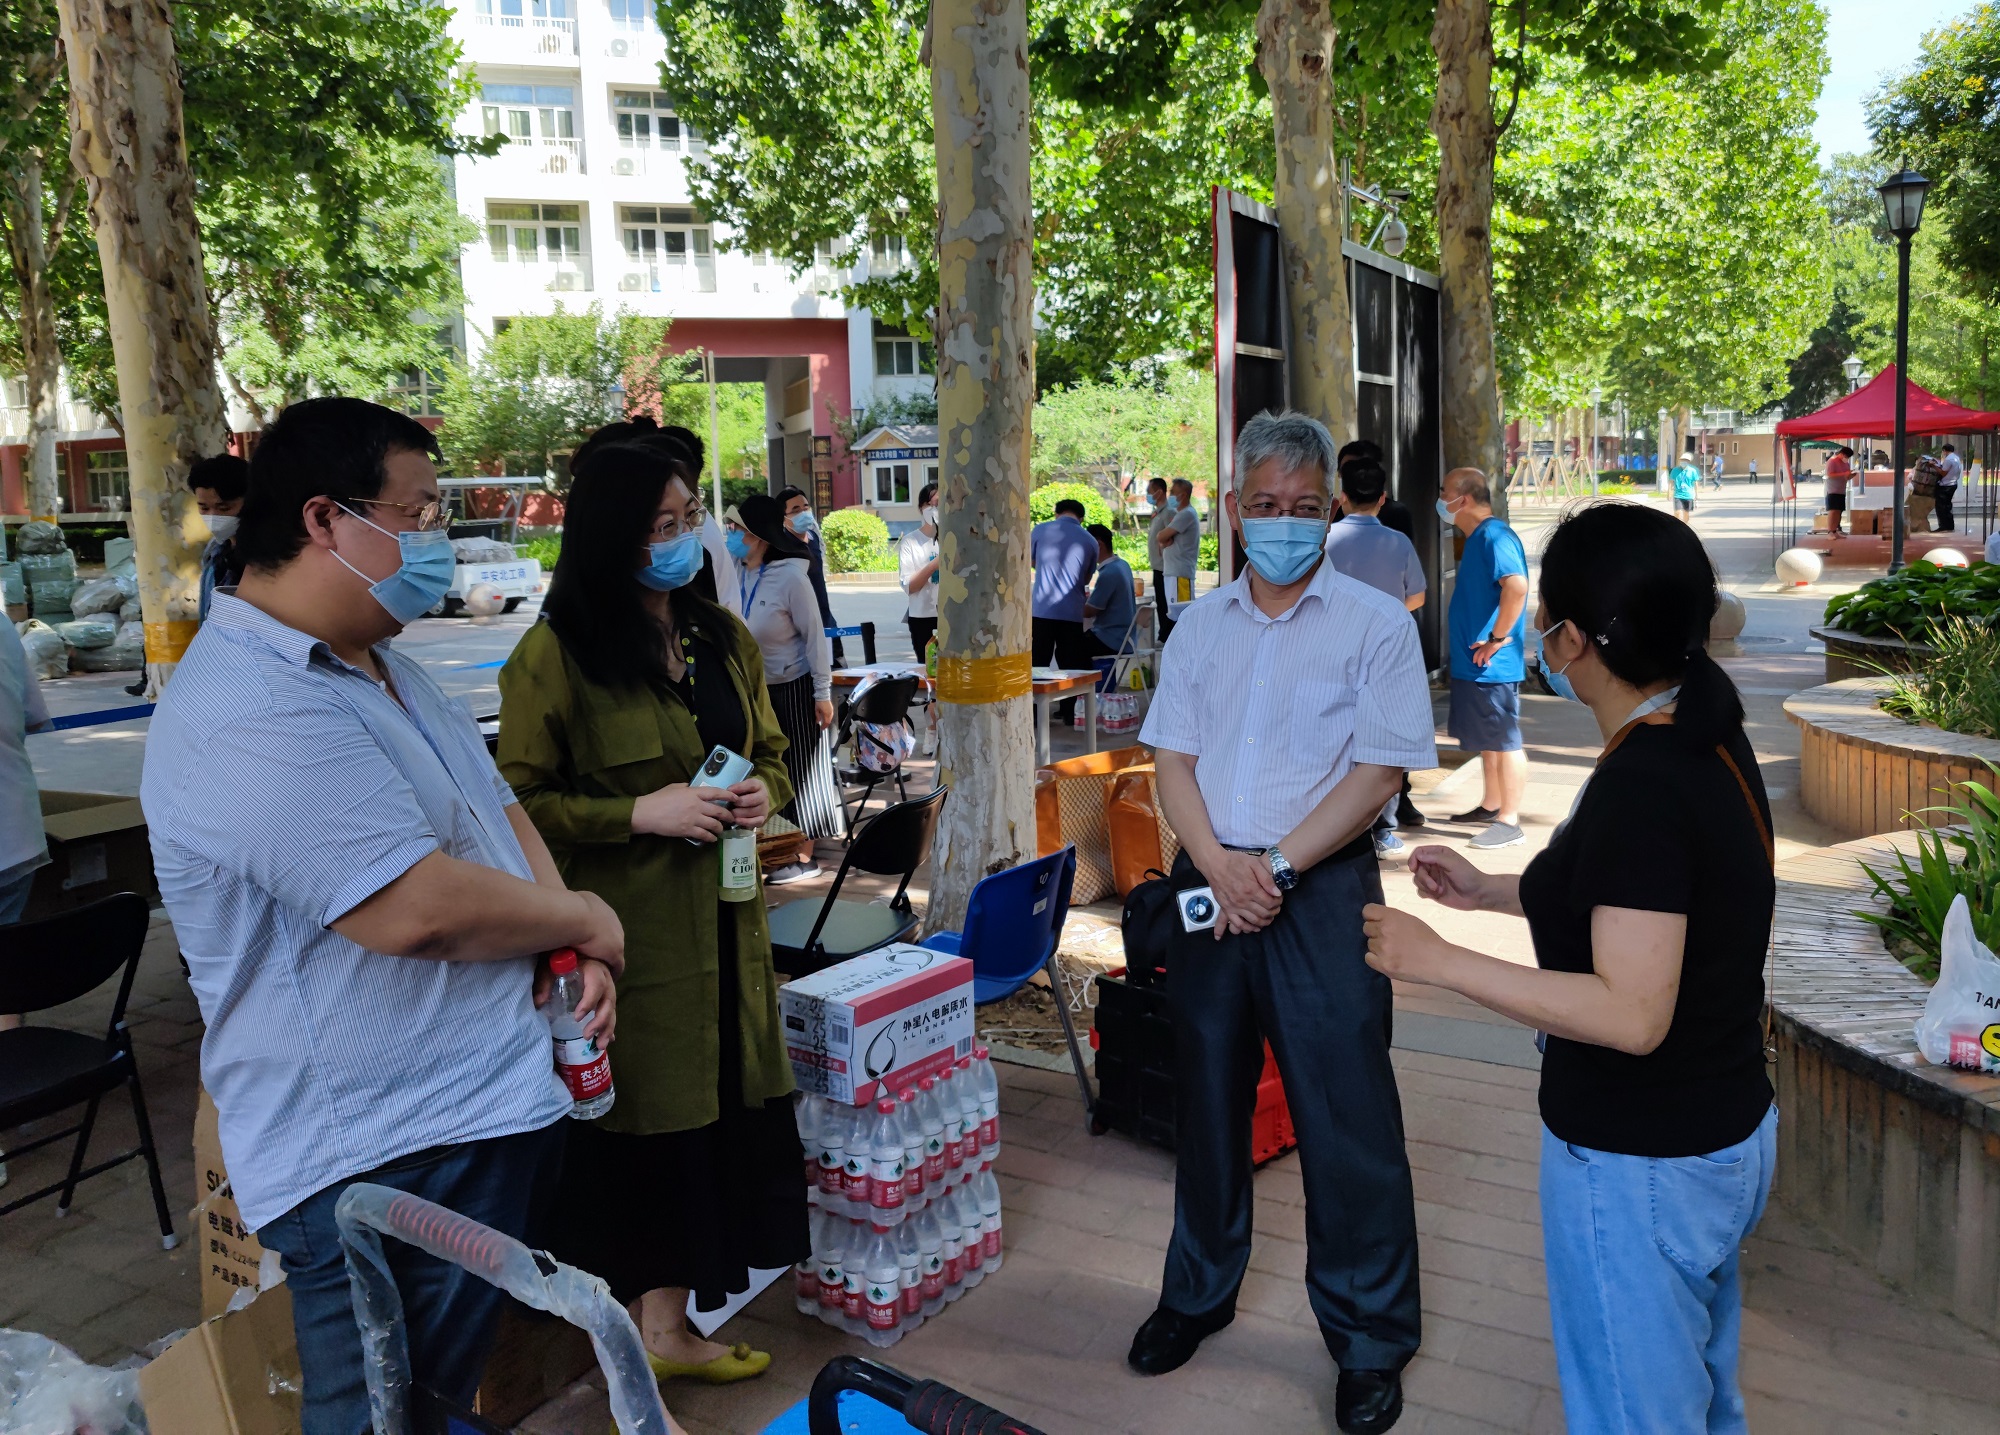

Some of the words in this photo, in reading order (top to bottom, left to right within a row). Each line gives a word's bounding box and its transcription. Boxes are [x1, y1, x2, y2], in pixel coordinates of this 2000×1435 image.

[481, 568, 526, 581] 平安北工商
[902, 996, 968, 1032] 外星人电解质水
[580, 1056, 609, 1081] 农夫山
